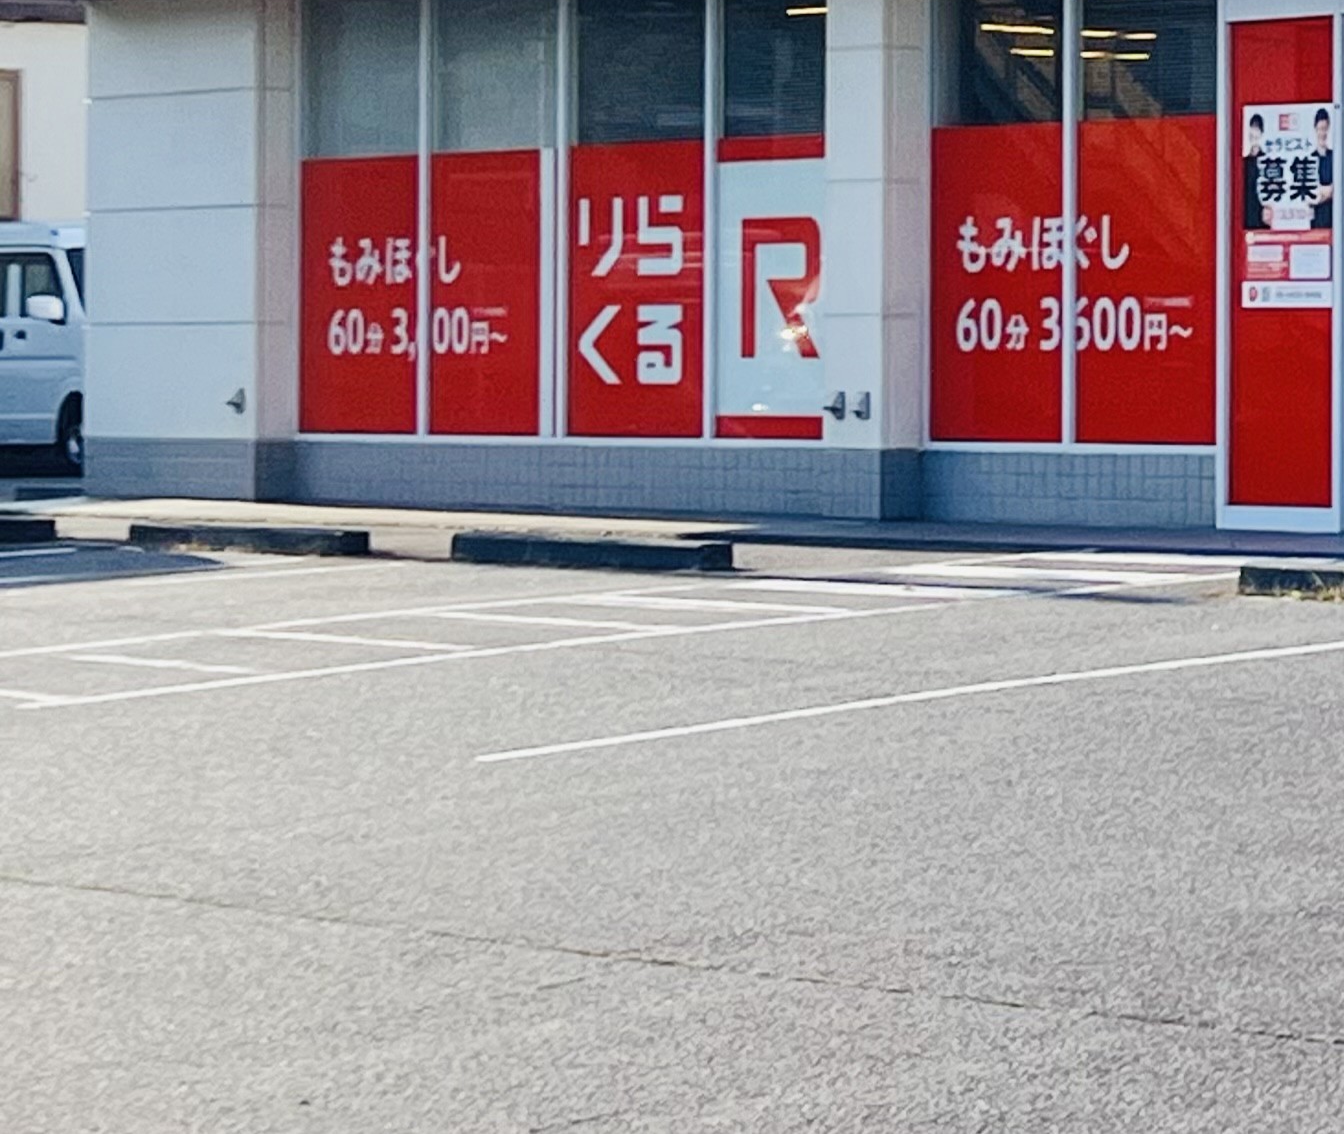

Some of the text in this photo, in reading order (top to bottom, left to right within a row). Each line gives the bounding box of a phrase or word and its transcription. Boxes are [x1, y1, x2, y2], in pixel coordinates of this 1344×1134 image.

[1260, 156, 1318, 202] 募集
[329, 236, 461, 287] もみほし
[740, 216, 822, 359] R
[328, 306, 508, 362] 60分 3,00円〜
[956, 298, 1030, 352] 60分
